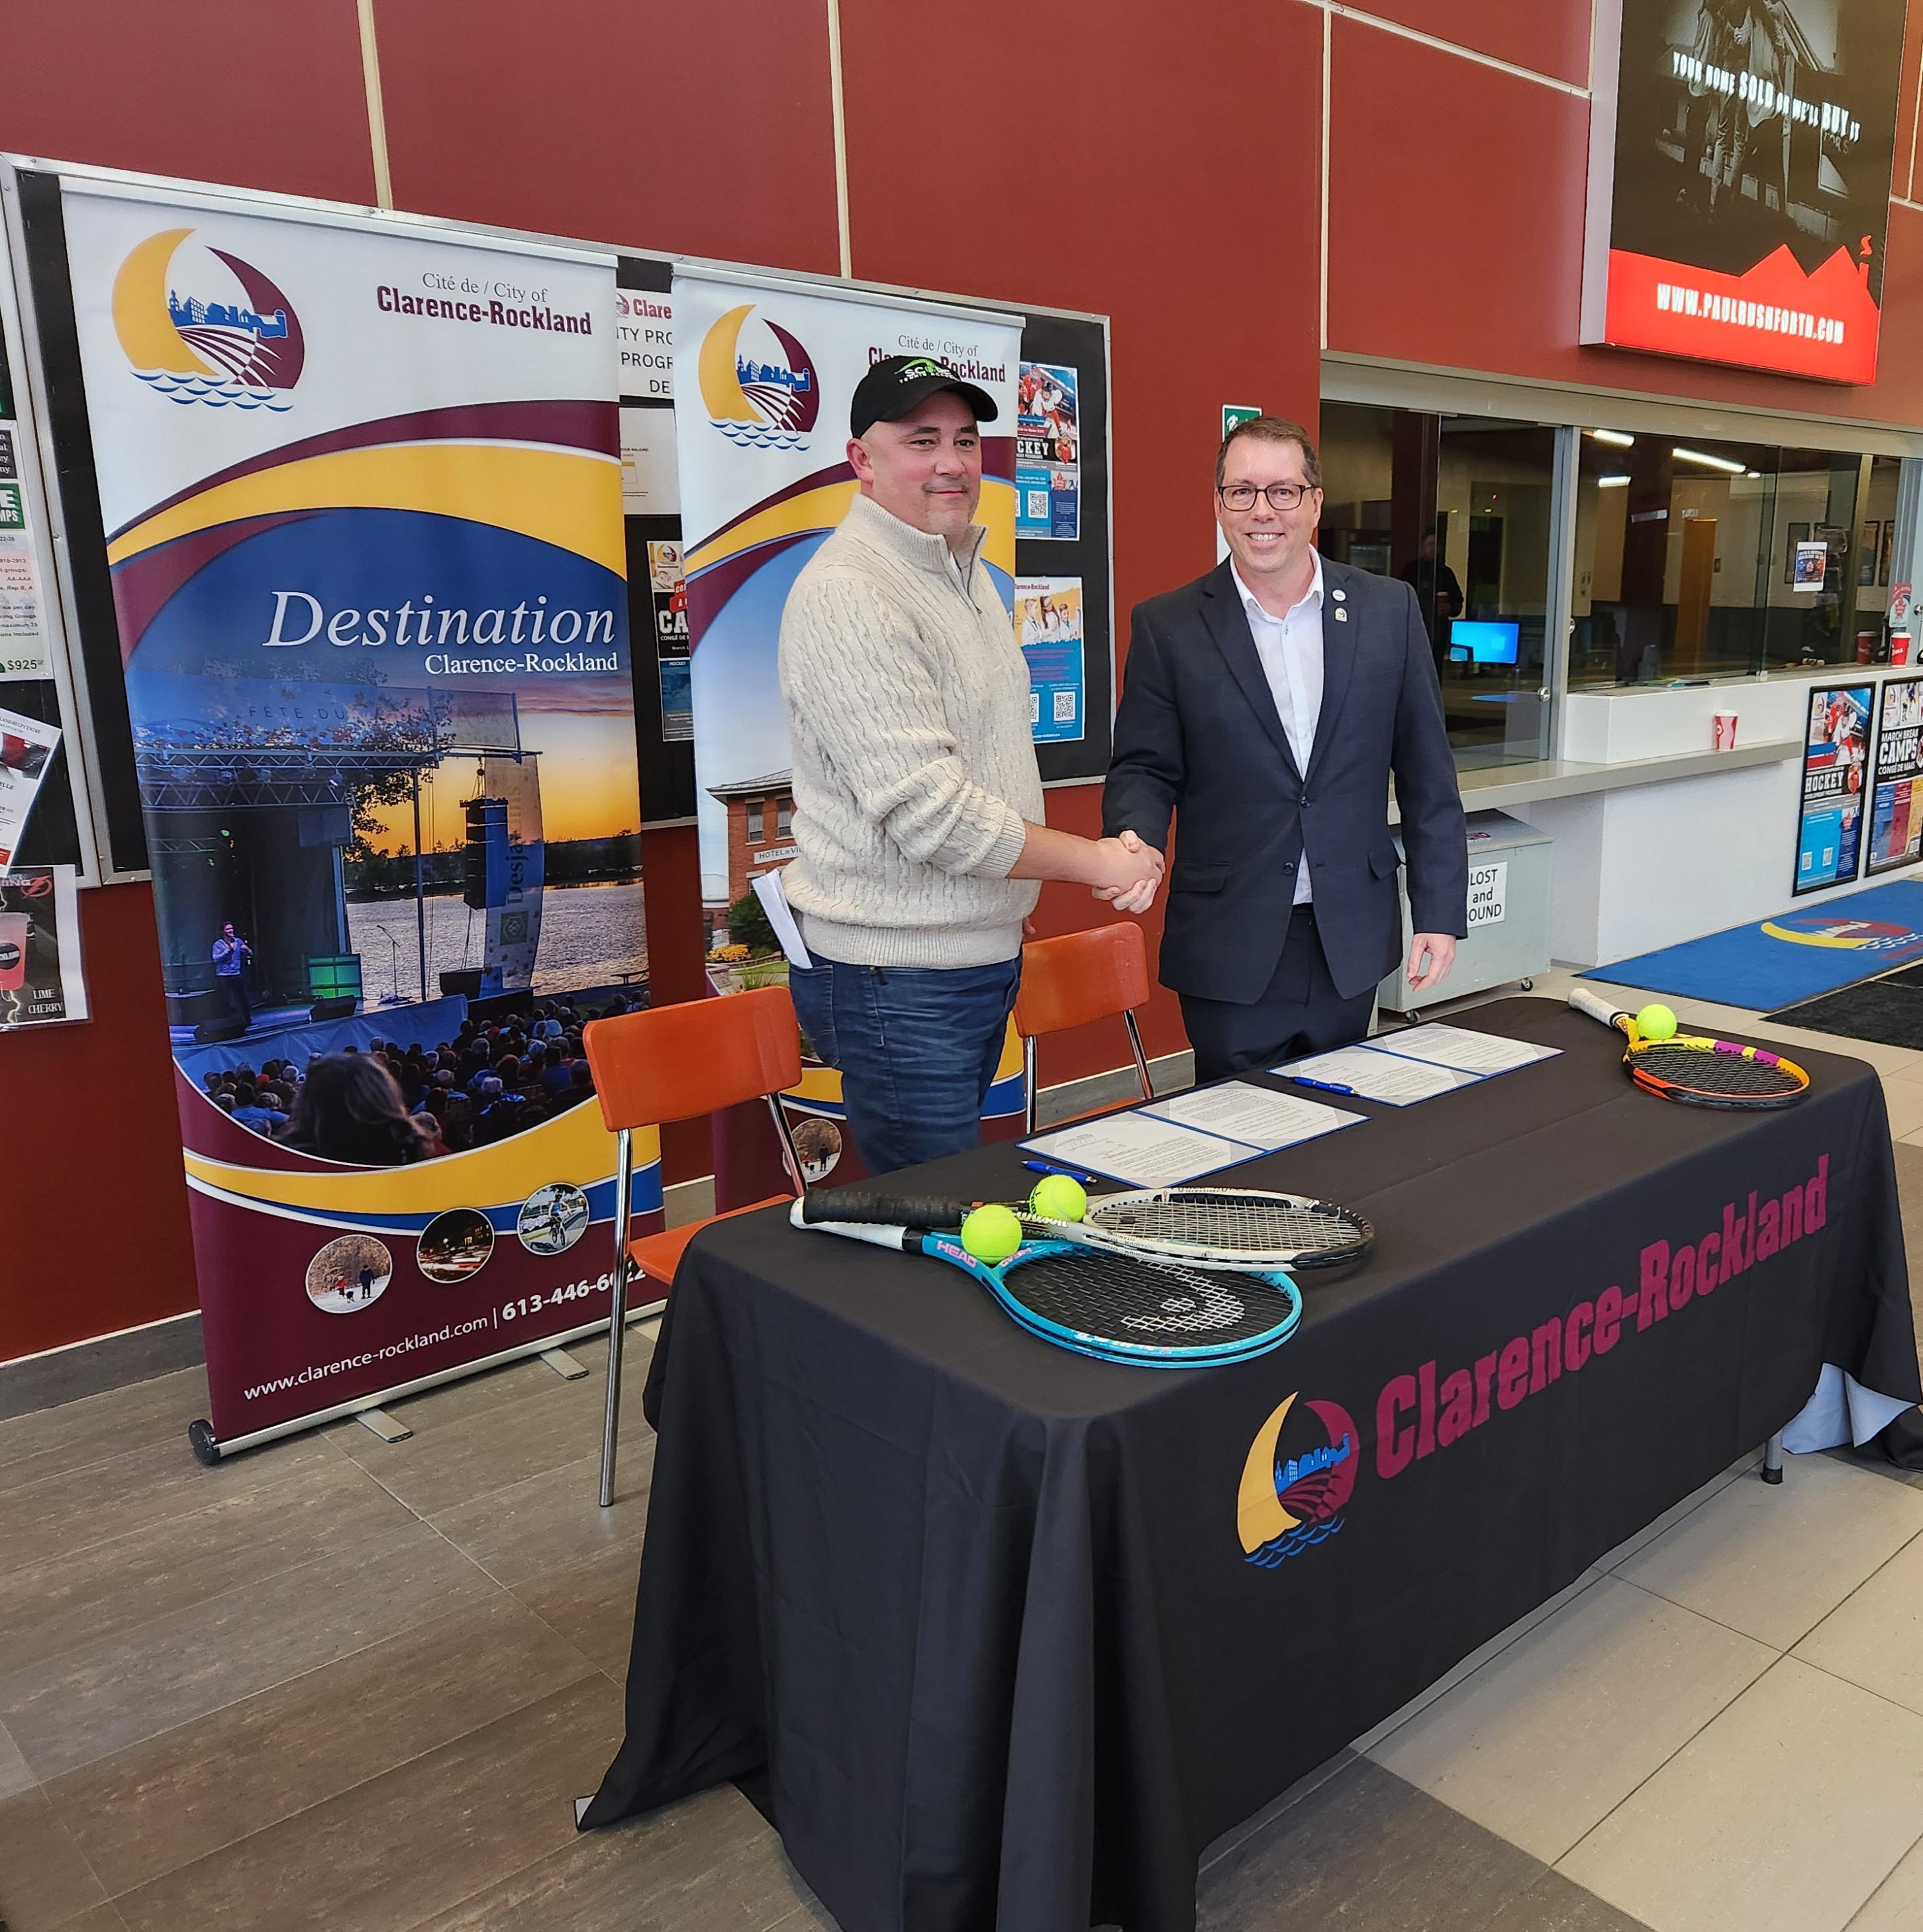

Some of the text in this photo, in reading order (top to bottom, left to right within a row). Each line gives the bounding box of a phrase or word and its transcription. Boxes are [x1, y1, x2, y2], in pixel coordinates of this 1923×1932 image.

[1673, 51, 1702, 83] YOUR
[1705, 64, 1736, 95] HOME
[1738, 71, 1775, 109] SOLD
[1776, 91, 1790, 116] OR
[1822, 102, 1849, 137] BUY
[1849, 121, 1861, 142] IT
[422, 272, 456, 291] Cité
[460, 278, 479, 294] de
[493, 281, 526, 303] City
[531, 288, 548, 303] of
[377, 285, 593, 335] Clarence-Rockland
[1657, 282, 1845, 344] WWW.PAULRUSHFORTH.COM
[898, 334, 919, 349] Cité
[922, 338, 934, 351] de
[944, 342, 964, 358] City
[967, 345, 979, 357] of
[868, 346, 1007, 383] ClRockland
[262, 590, 616, 647] Destination
[7, 659, 38, 671] $925
[424, 652, 619, 675] Clarence-Rockland
[1881, 731, 1903, 742] MARCH
[1879, 738, 1918, 764] CAMPS
[1878, 763, 1897, 775] CONGÉ
[1897, 763, 1904, 772] DE
[1804, 771, 1844, 793] HOCKEY
[1470, 869, 1498, 886] LOST
[1473, 886, 1493, 903] and
[1469, 903, 1502, 922] OUND
[33, 988, 56, 999] LIME
[28, 1003, 64, 1014] CHERRY
[936, 1240, 978, 1268] HEAD
[1375, 1152, 1830, 1481] Clarence-Rockland
[243, 1315, 488, 1400] www.clarence-rockland.com
